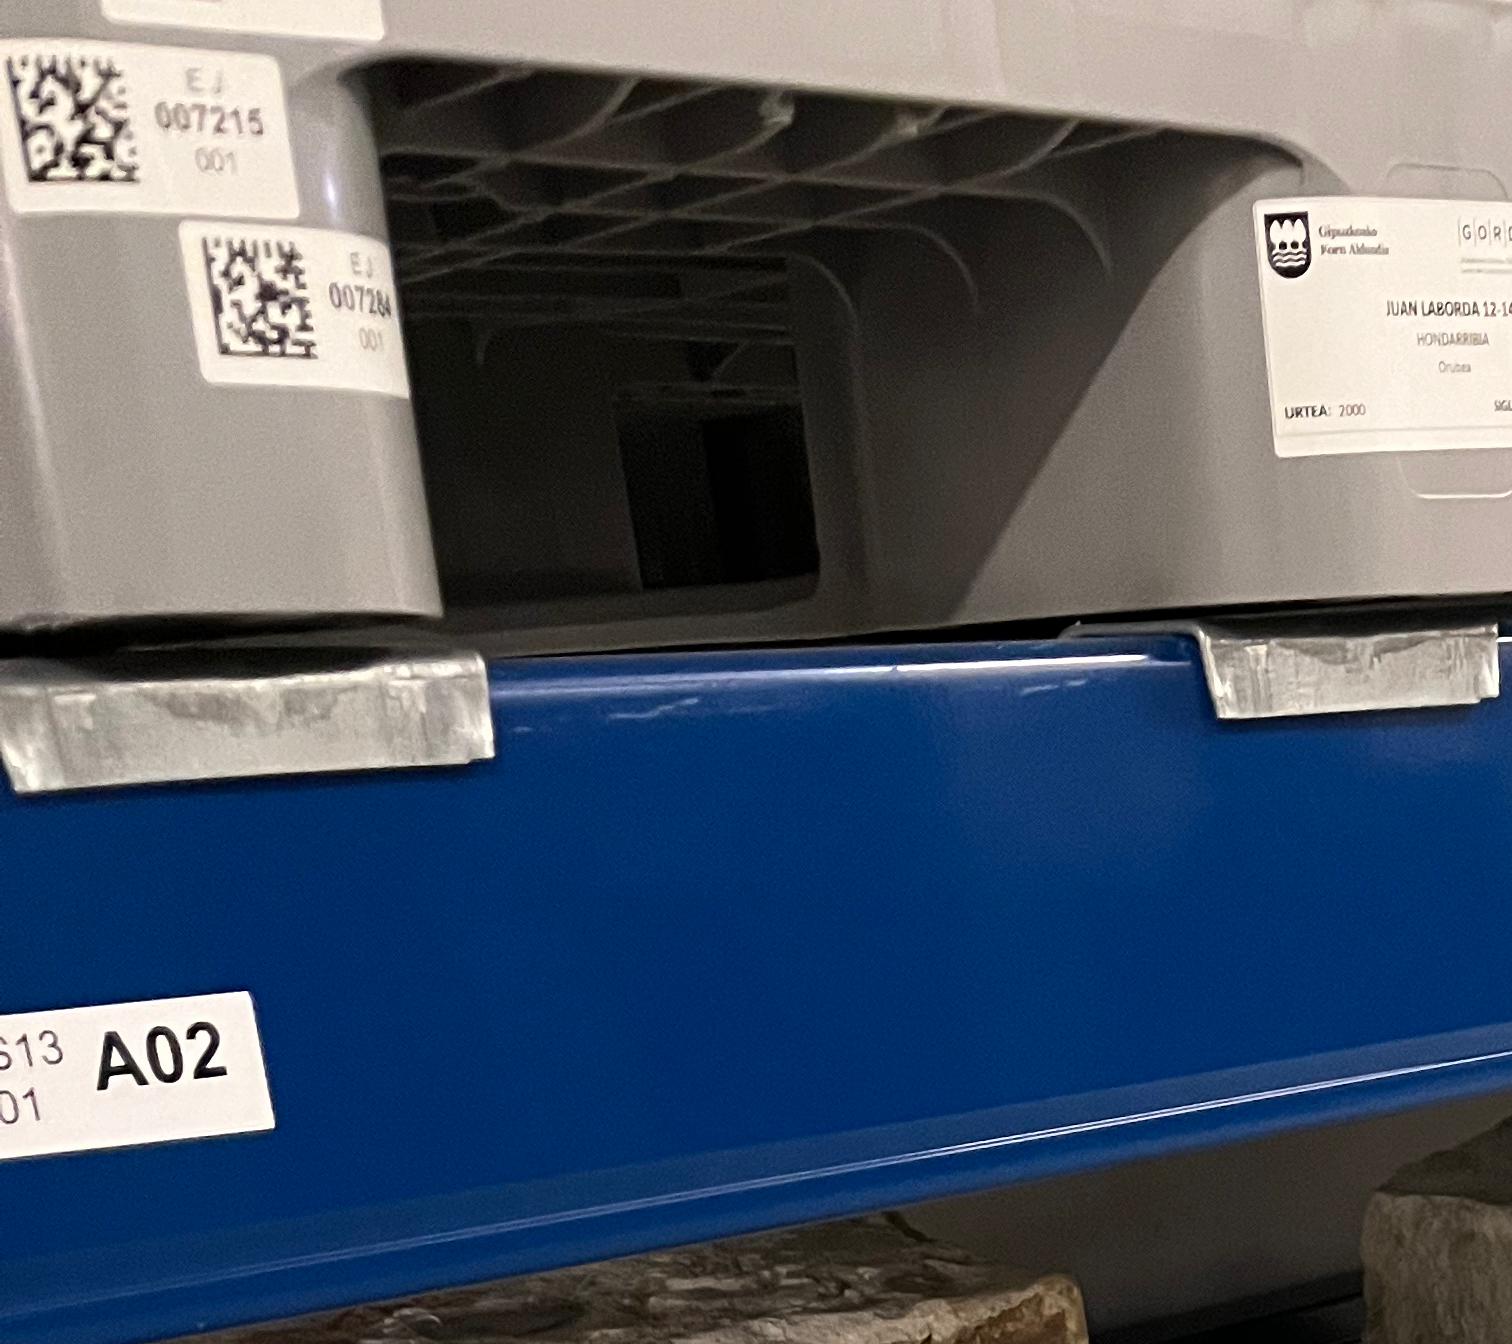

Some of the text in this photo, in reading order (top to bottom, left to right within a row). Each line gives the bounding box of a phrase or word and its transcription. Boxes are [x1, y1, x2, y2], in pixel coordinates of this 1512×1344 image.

[154, 101, 264, 136] 007215
[194, 147, 239, 176] 001
[1386, 300, 1418, 317] JUAN
[1421, 301, 1480, 317] LABORDA
[359, 327, 385, 352] 001
[1339, 402, 1367, 418] 2000
[97, 1021, 228, 1091] A02
